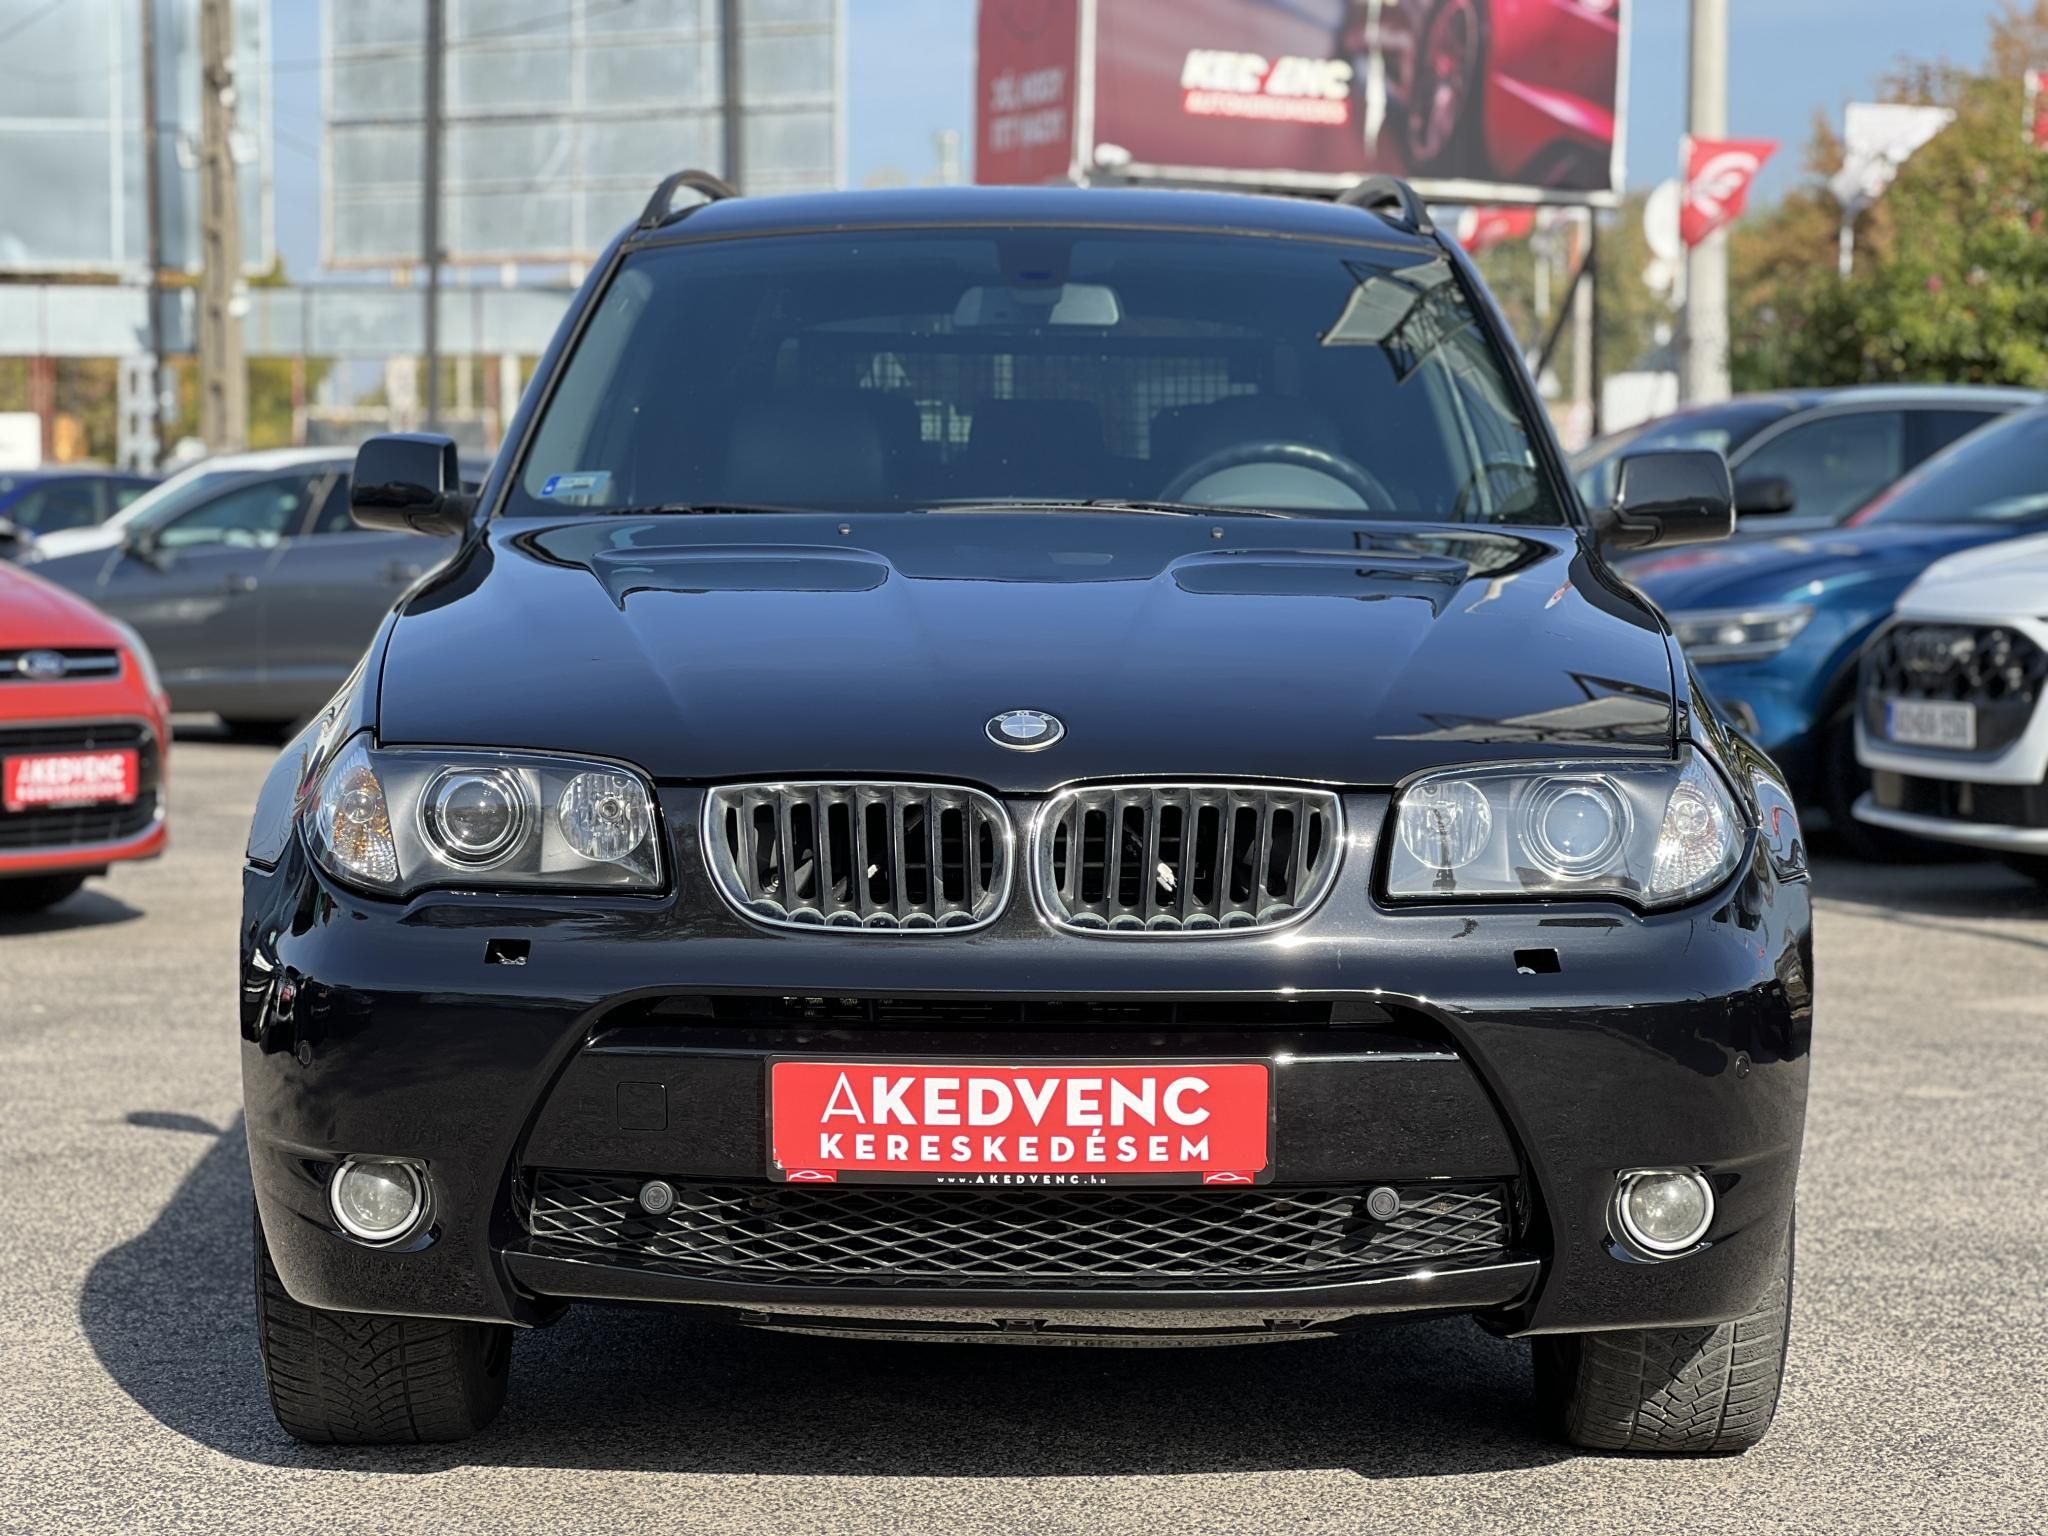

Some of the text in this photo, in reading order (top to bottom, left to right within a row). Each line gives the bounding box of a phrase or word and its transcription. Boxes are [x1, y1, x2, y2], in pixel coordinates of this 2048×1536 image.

[820, 1071, 1210, 1127] AKEDVENC
[820, 1129, 1210, 1162] KERESKEDÉSEM
[937, 1174, 1106, 1185] www.AKEDVENC.hu
